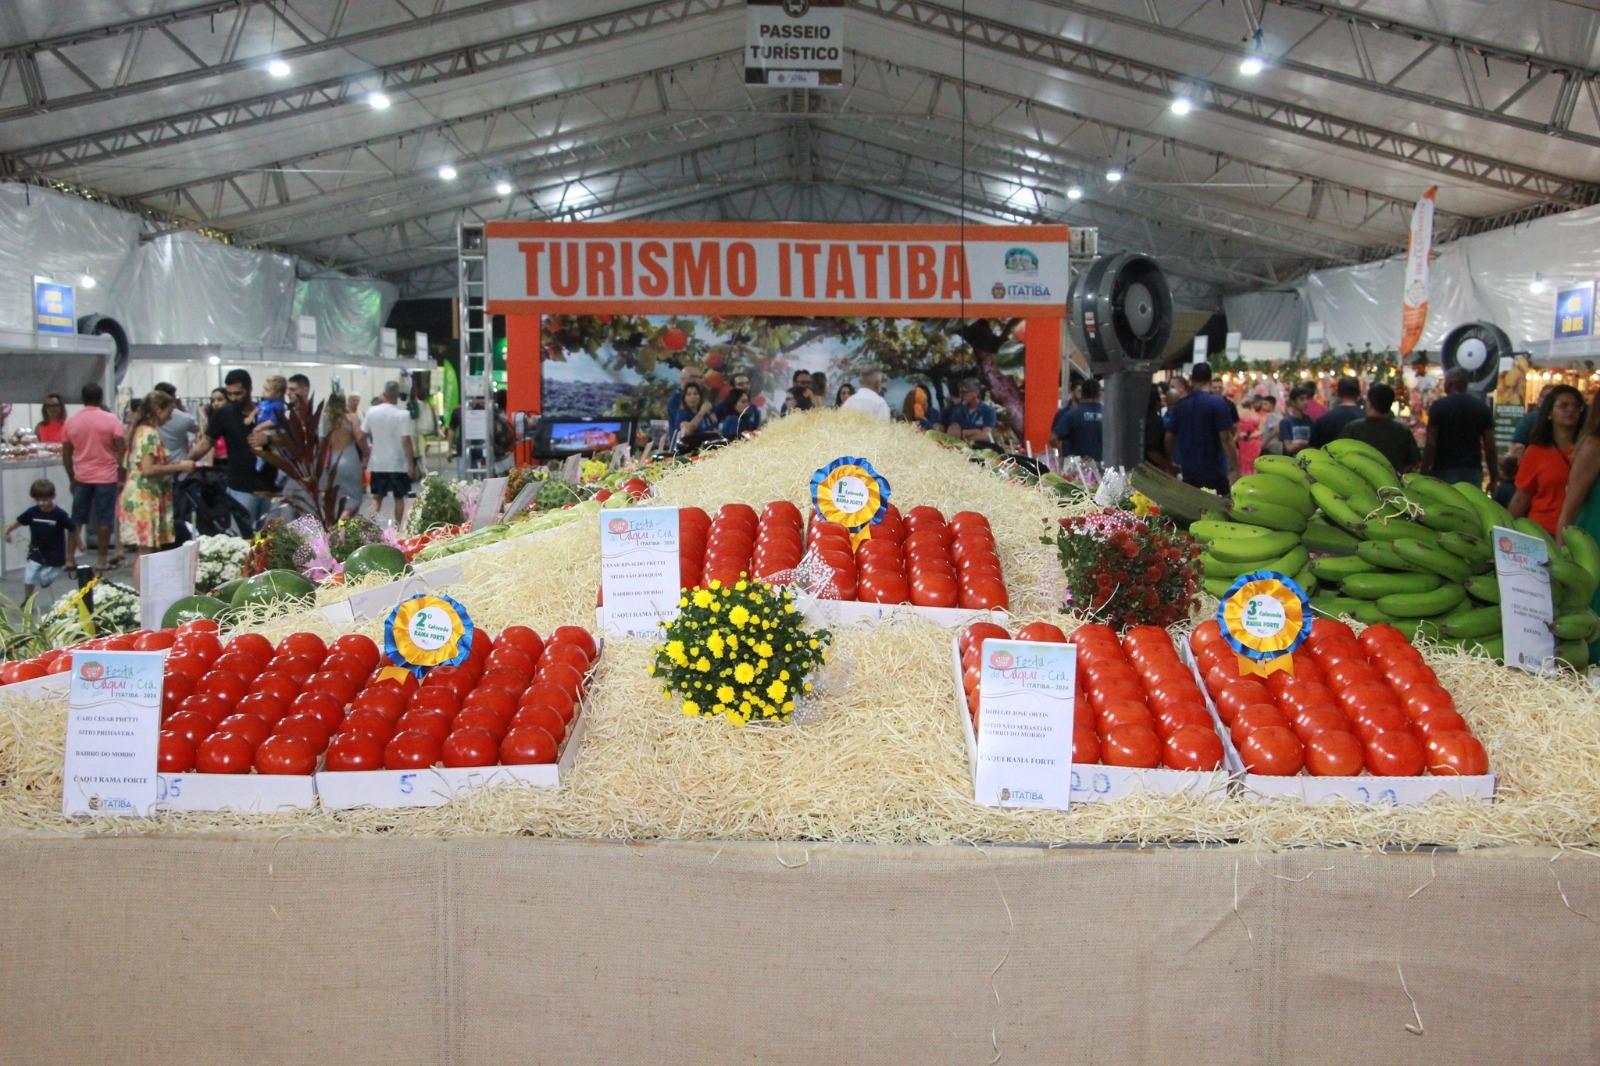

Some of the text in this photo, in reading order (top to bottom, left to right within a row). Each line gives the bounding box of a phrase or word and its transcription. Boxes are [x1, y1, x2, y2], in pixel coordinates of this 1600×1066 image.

[760, 24, 831, 39] PASSEIO
[750, 43, 839, 60] TURÍSTICO
[518, 241, 972, 299] TURISMO ITATIBA
[1008, 285, 1051, 296] ITATIBA
[1006, 756, 1029, 764] RAMA
[1030, 757, 1056, 766] FORTE
[74, 775, 98, 783] CAQUI
[1012, 790, 1044, 800] ITATIBA
